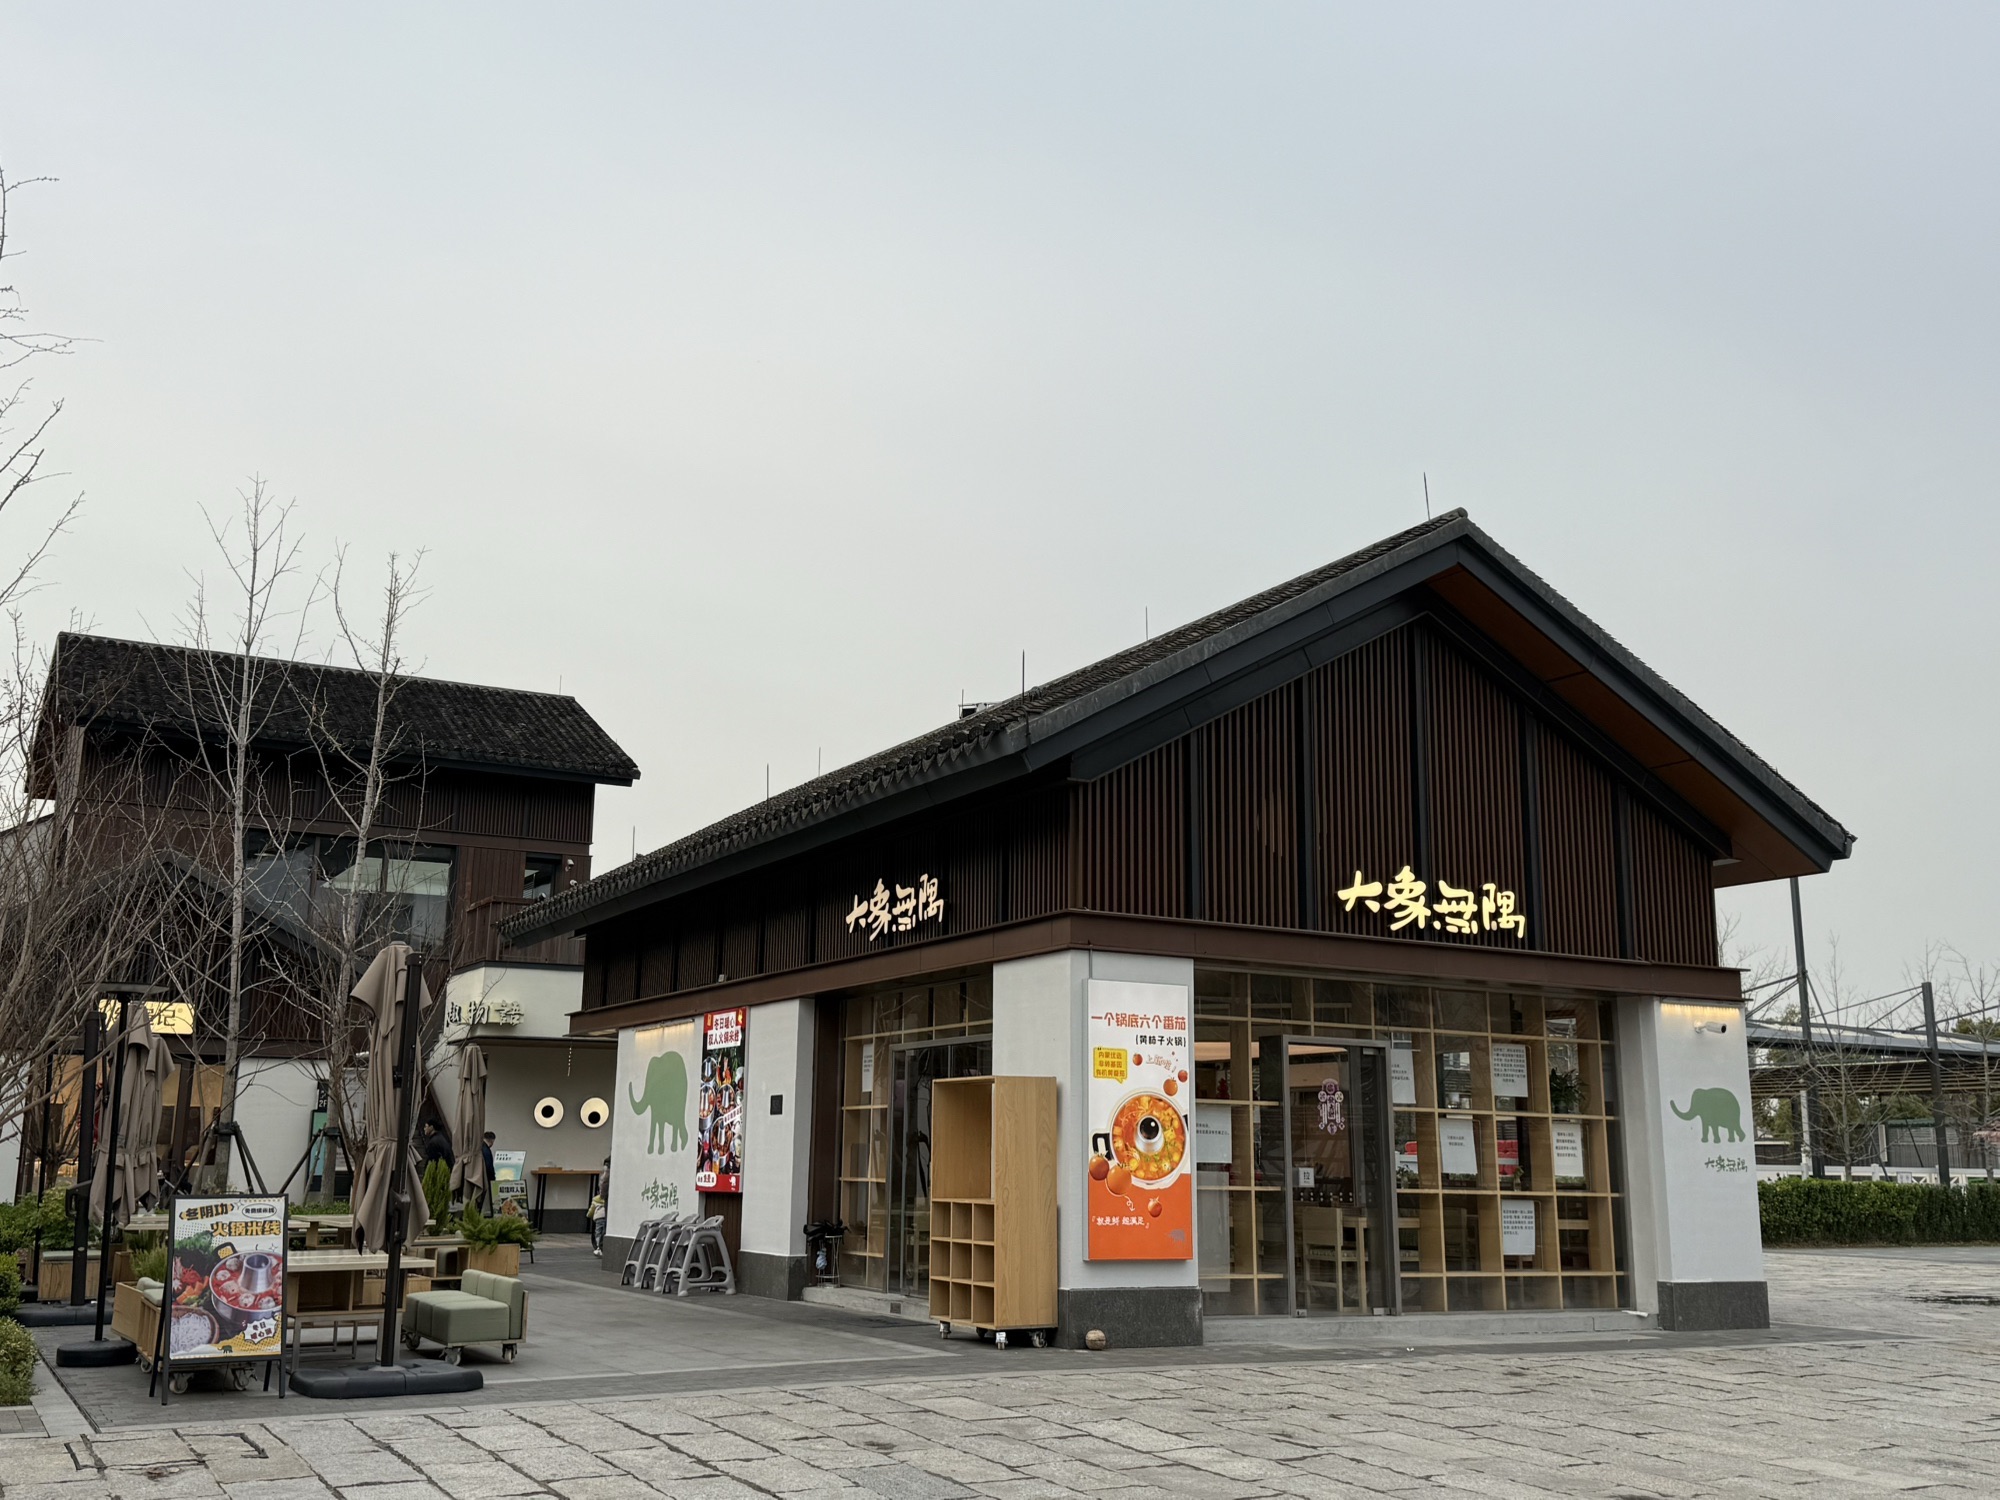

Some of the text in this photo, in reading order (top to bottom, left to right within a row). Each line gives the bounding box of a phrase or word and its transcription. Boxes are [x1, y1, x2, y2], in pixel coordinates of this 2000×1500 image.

[845, 873, 944, 942] 大象無隅
[1338, 865, 1526, 938] 大象無隅
[1091, 1012, 1186, 1031] 一个锅底六个番茄
[211, 1220, 282, 1238] 火锅米线
